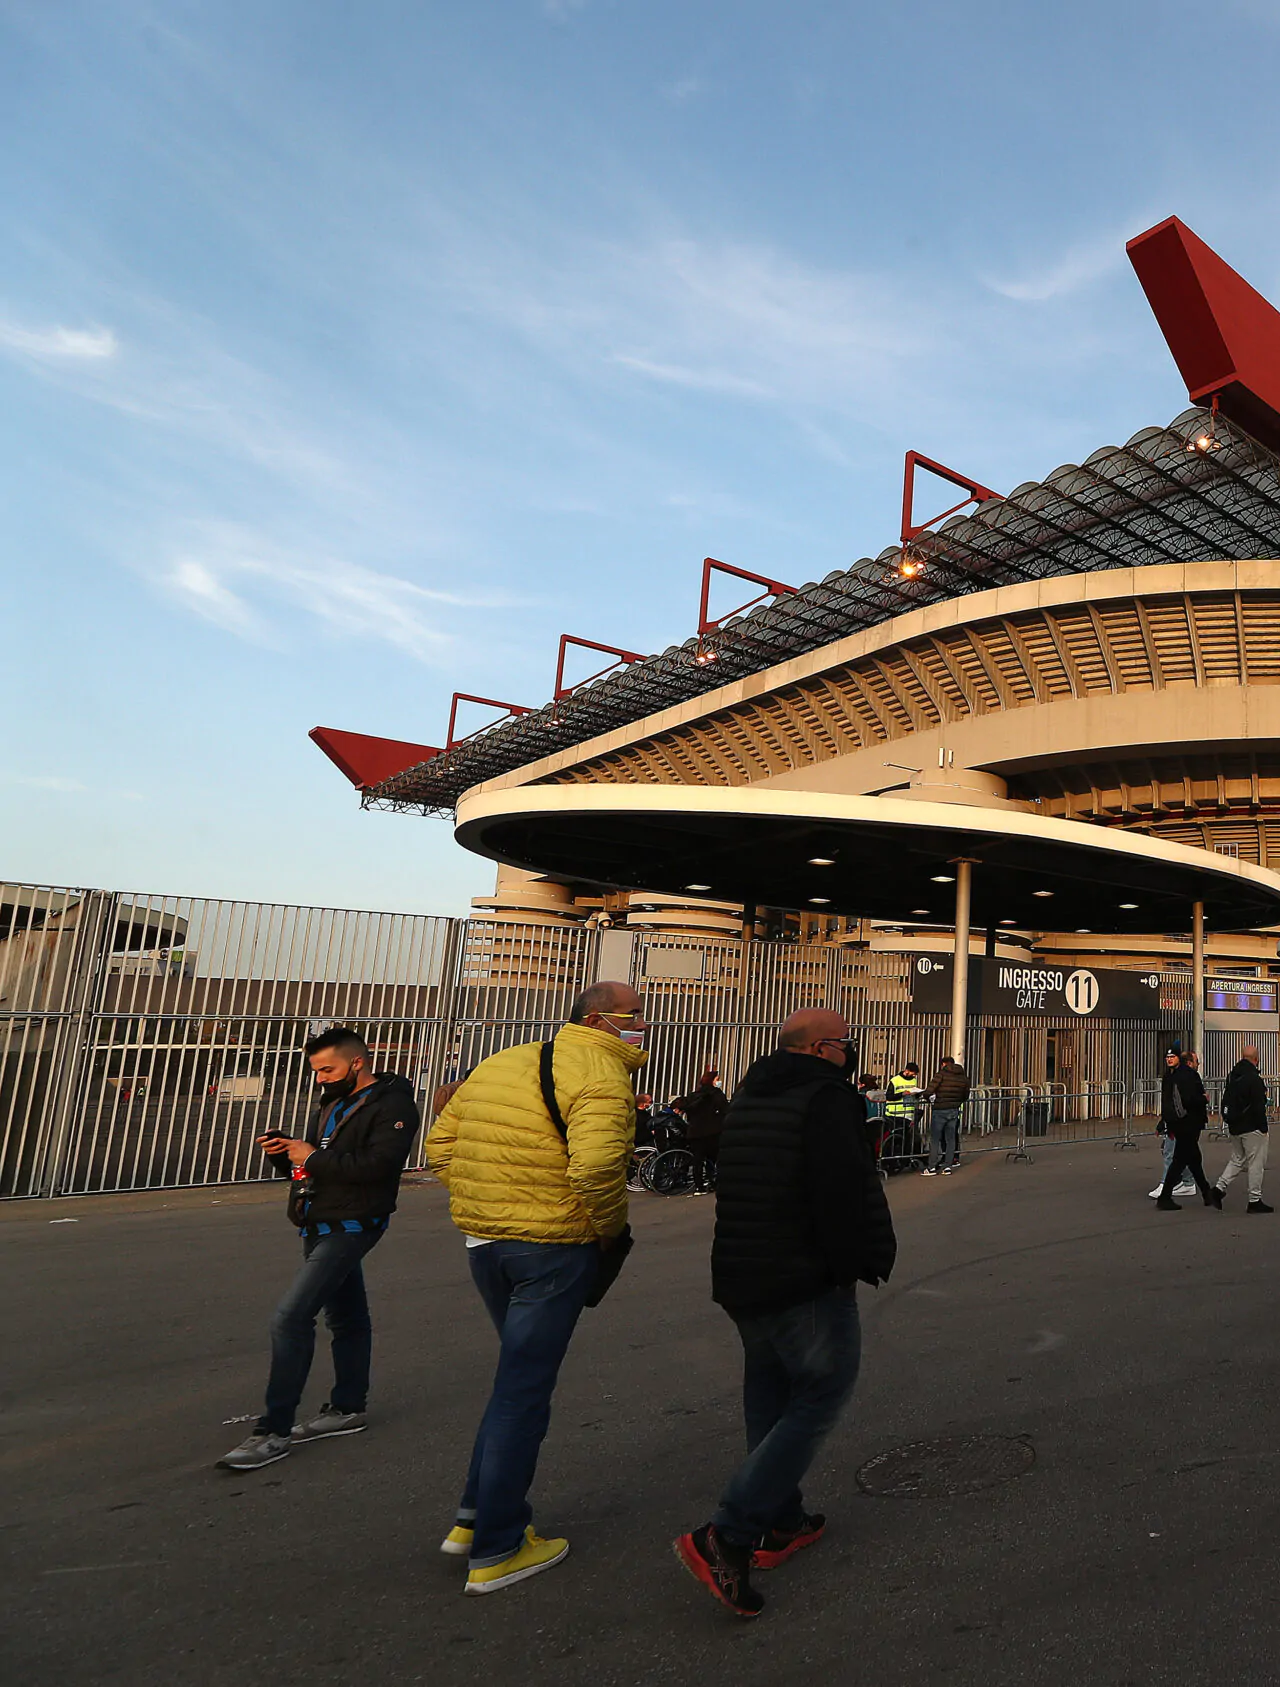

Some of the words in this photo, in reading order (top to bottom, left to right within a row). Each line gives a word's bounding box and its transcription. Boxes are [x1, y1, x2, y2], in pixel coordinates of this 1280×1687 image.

[919, 959, 930, 973] 10
[999, 967, 1063, 992] INGRESSO
[1071, 975, 1094, 1009] 11
[1211, 980, 1245, 992] APERTURA
[1245, 983, 1273, 994] INGRESSI
[1016, 989, 1046, 1010] GATE
